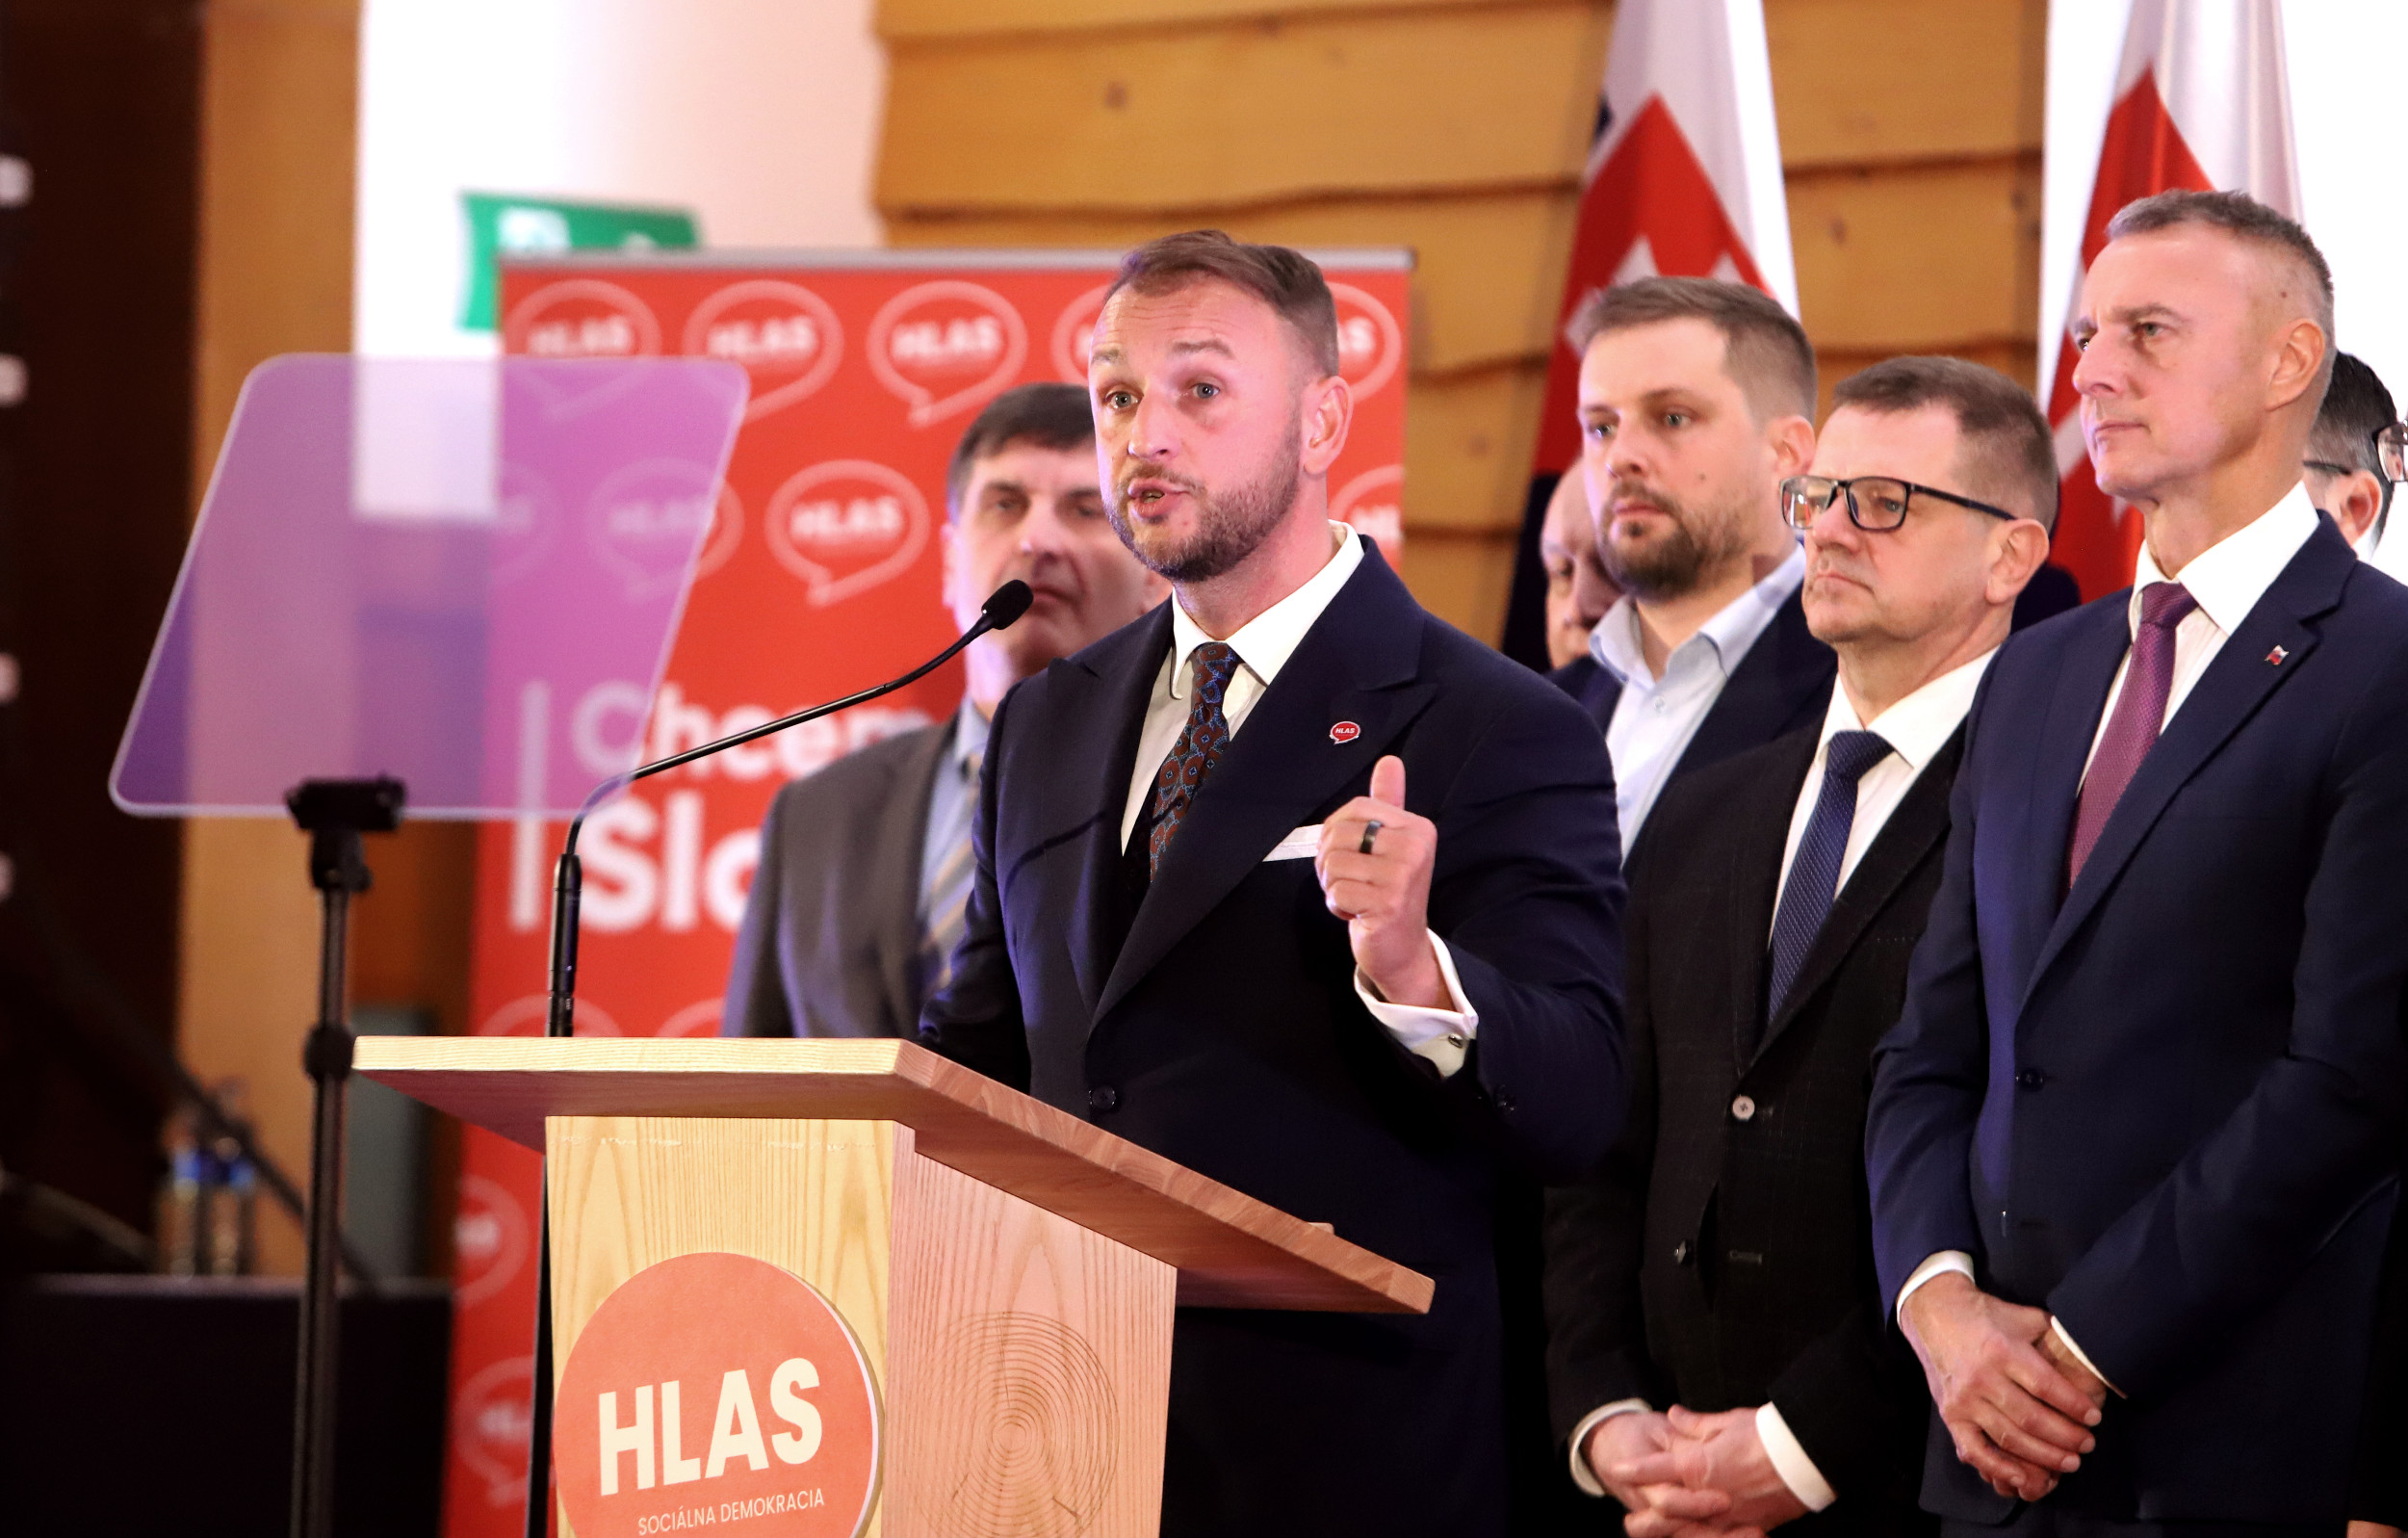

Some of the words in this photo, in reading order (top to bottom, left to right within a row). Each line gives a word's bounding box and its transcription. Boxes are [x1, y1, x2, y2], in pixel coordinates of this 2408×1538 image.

[890, 314, 1003, 360] HLAS
[789, 494, 904, 540] HLAS
[598, 1357, 823, 1497] HLAS
[638, 1505, 716, 1536] SOCIÁLNA
[720, 1488, 825, 1523] DEMOKRACIA
